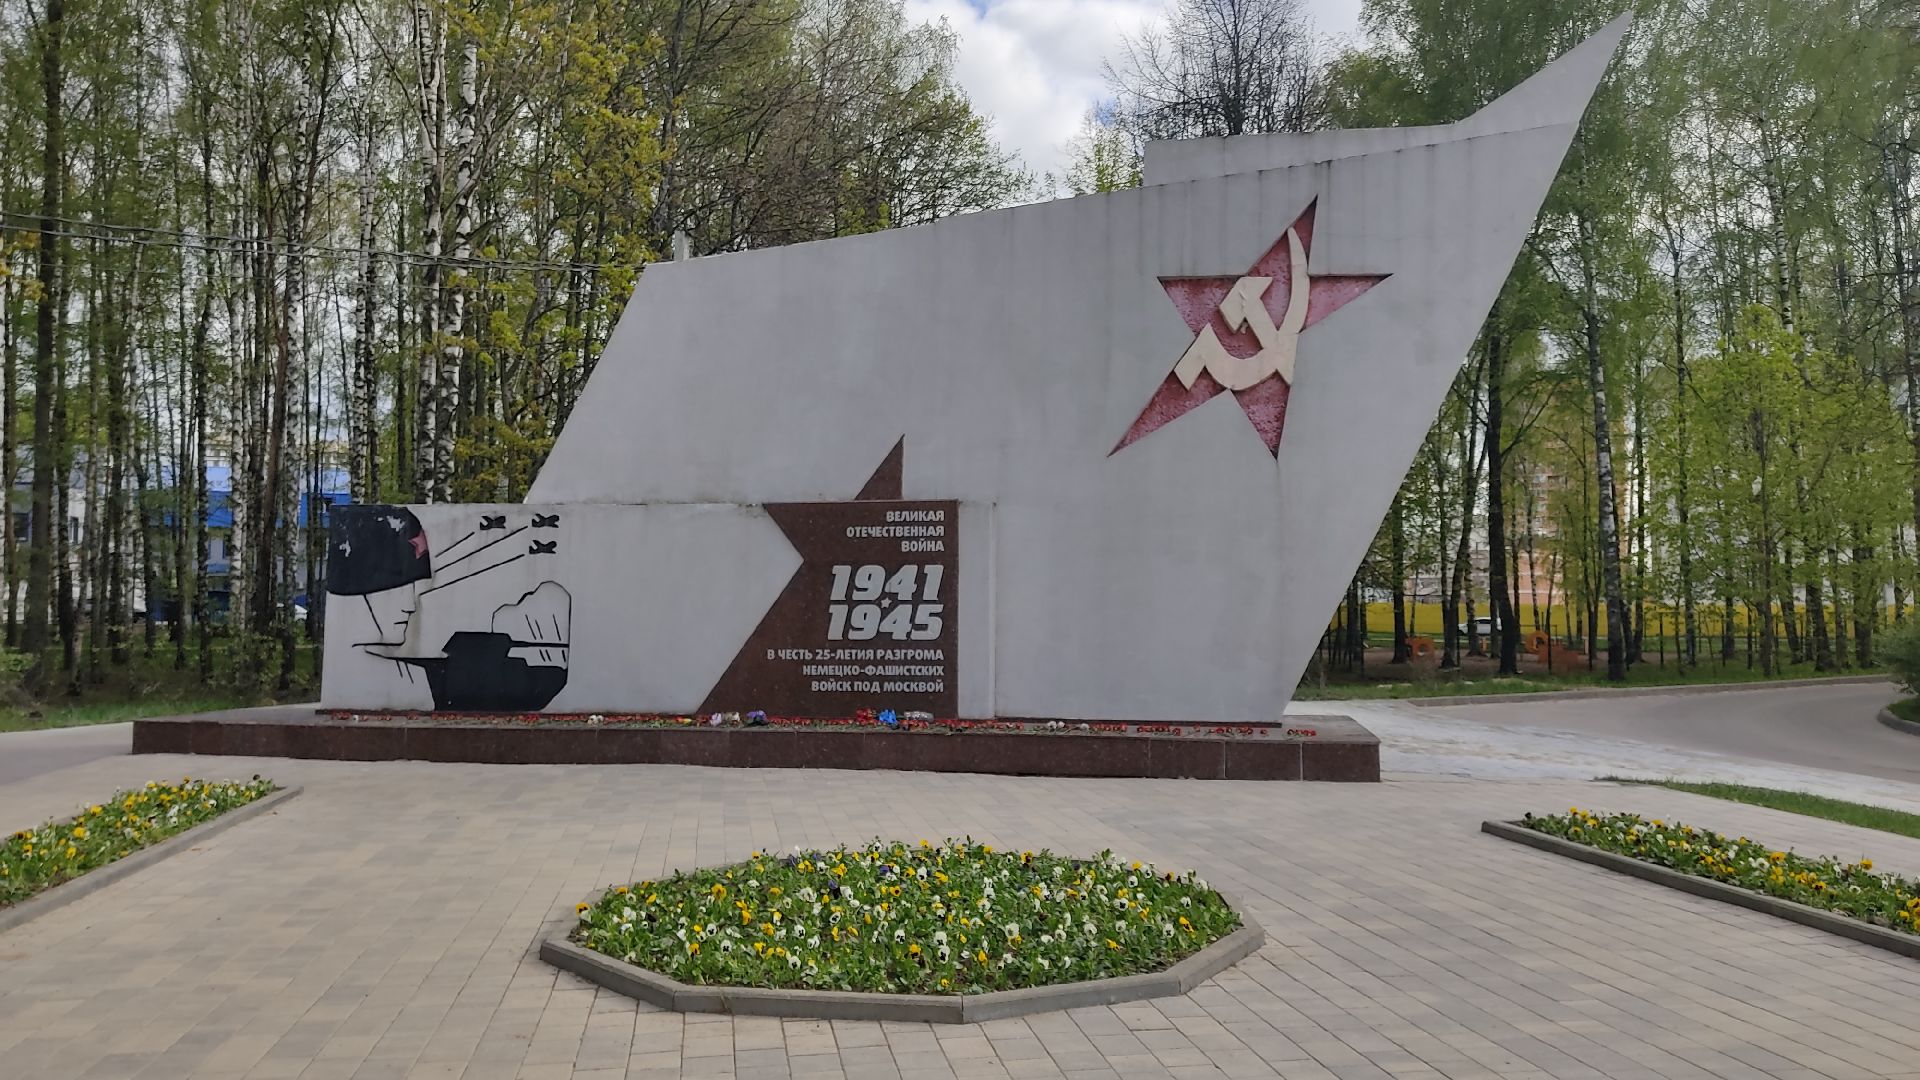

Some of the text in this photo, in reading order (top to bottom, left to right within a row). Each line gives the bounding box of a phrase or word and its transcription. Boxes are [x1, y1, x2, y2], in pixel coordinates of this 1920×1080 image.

[886, 510, 945, 522] ВЕЛИКАЯ
[846, 526, 945, 538] ОТЕЧЕСТВЕННАЯ
[901, 539, 945, 552] ВОЙНА
[829, 564, 945, 601] 1941
[827, 603, 944, 641] 1945
[767, 649, 945, 661] В ЧЕСТЬ 25-ЛЕТИЯ РАЗГРОМА
[802, 664, 945, 677] НЕМЕЦКО-ФАШИСТСКИХ
[811, 679, 944, 694] ВОЙСК ПОД МОСКВОЙ
